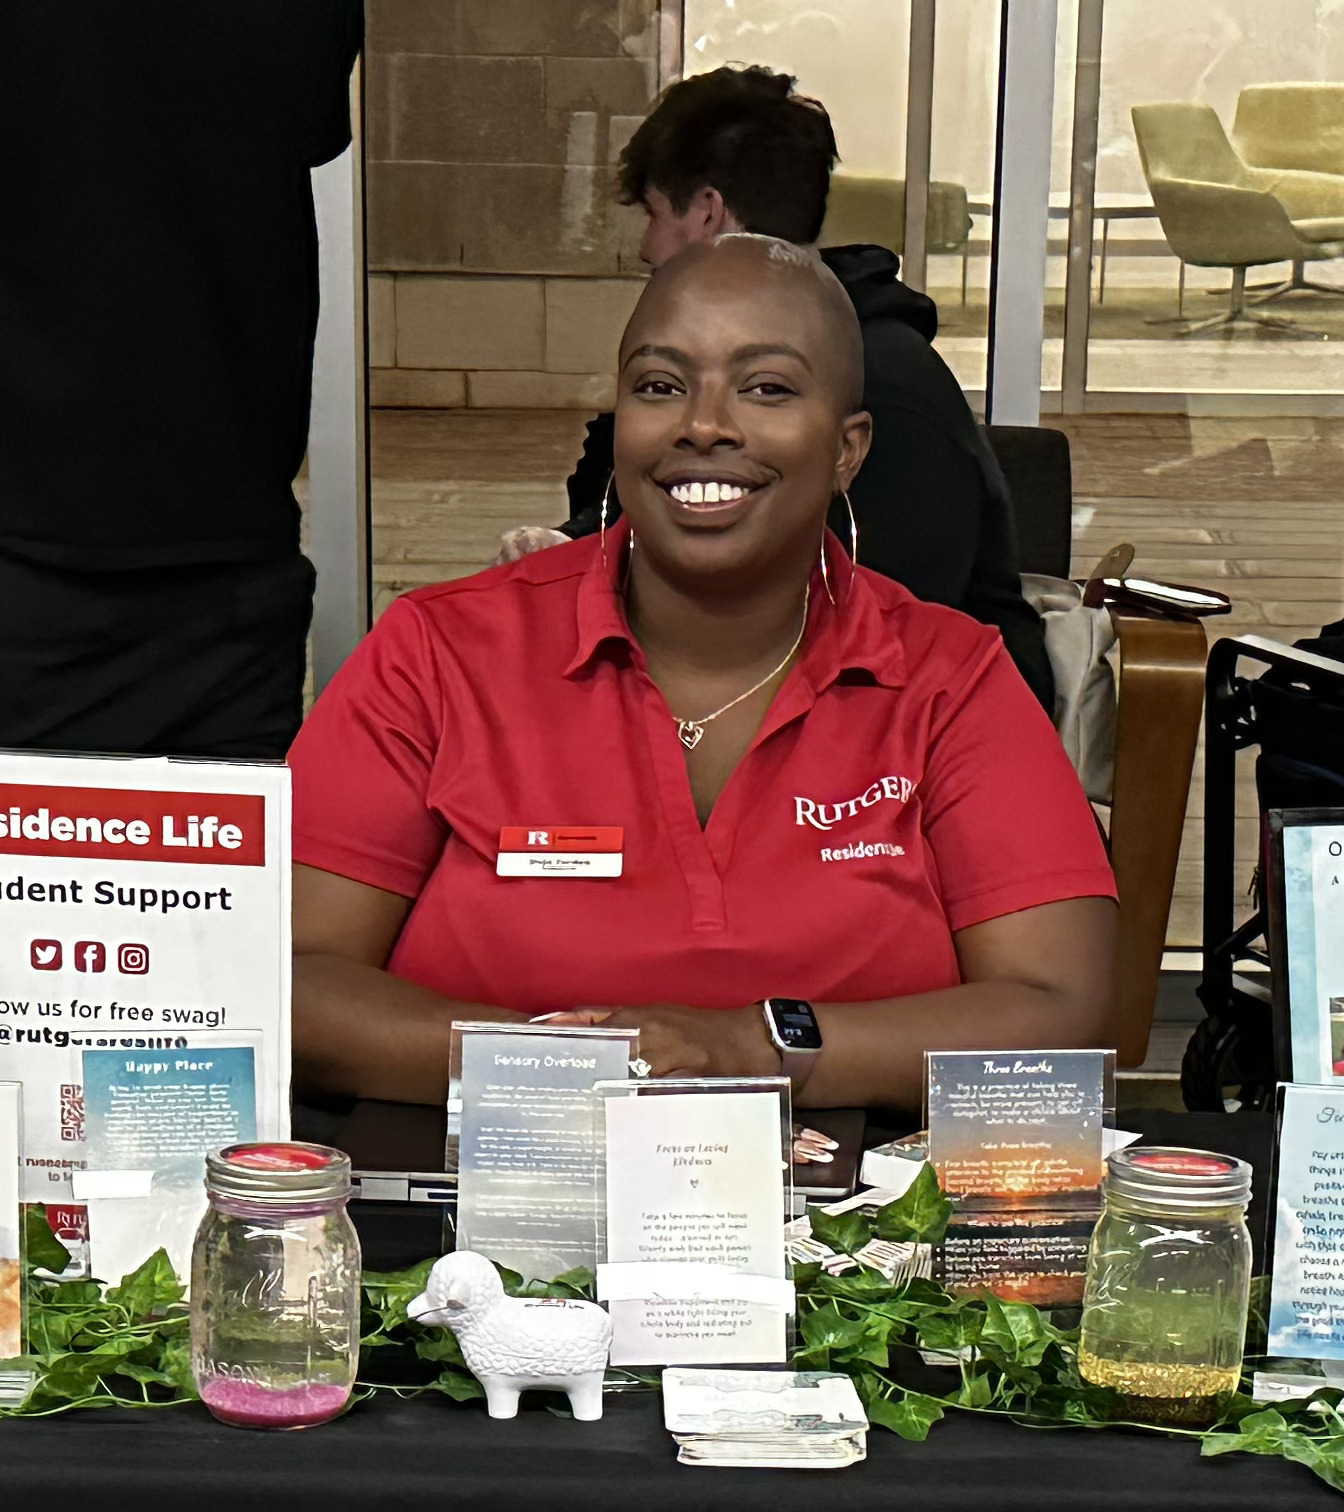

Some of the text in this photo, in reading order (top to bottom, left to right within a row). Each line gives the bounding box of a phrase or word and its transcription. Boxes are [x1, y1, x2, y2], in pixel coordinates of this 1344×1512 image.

[794, 776, 918, 830] RUTGER
[163, 816, 243, 849] Life
[528, 831, 549, 845] R
[1331, 876, 1339, 885] A
[94, 881, 232, 913] Support
[37, 1000, 62, 1017] us
[71, 999, 102, 1019] for
[110, 1002, 154, 1022] free
[161, 1006, 226, 1026] swag!
[126, 1061, 213, 1074] Happy Place
[494, 1055, 596, 1069] Sensory Overload
[984, 1061, 1010, 1074] Three
